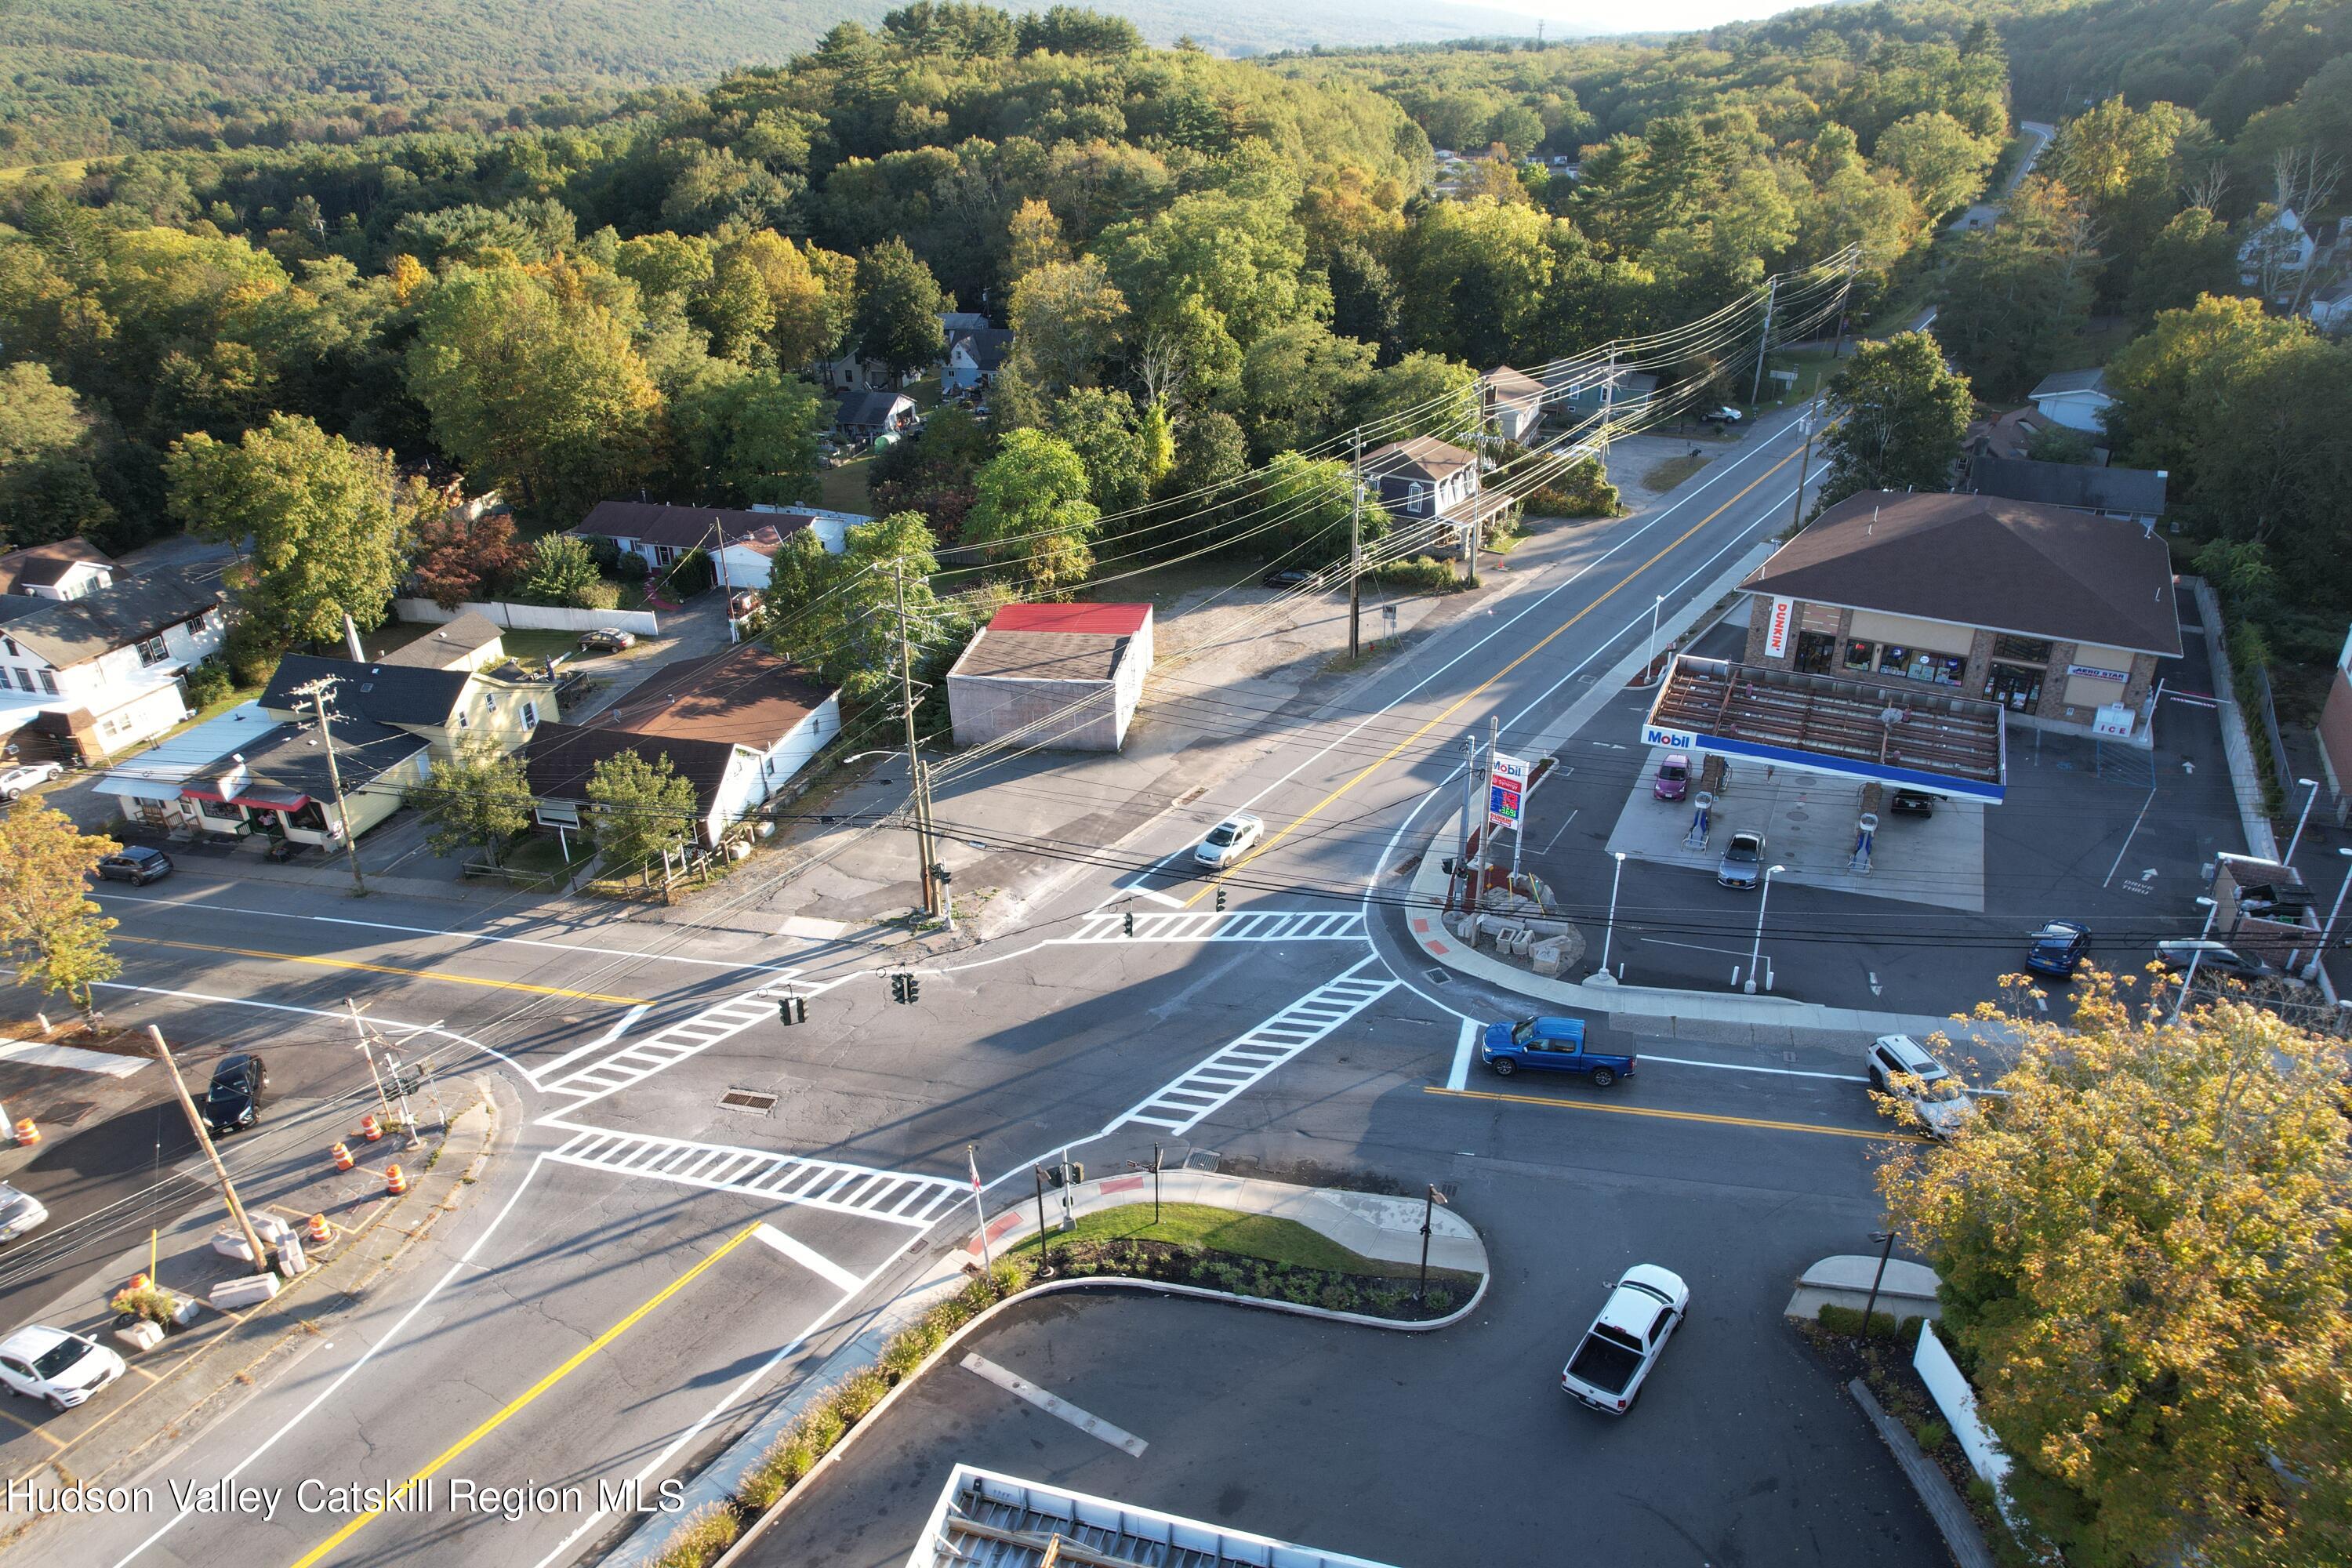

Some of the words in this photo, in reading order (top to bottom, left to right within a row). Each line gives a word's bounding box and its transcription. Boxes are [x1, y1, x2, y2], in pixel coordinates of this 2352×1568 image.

[1772, 604, 1788, 651] DUNKIN'
[2101, 724, 2126, 734] ICE
[1648, 730, 1690, 748] Mobil
[1498, 779, 1519, 790] Synergy
[2122, 885, 2149, 895] THRU
[2124, 880, 2154, 890] DRIVE
